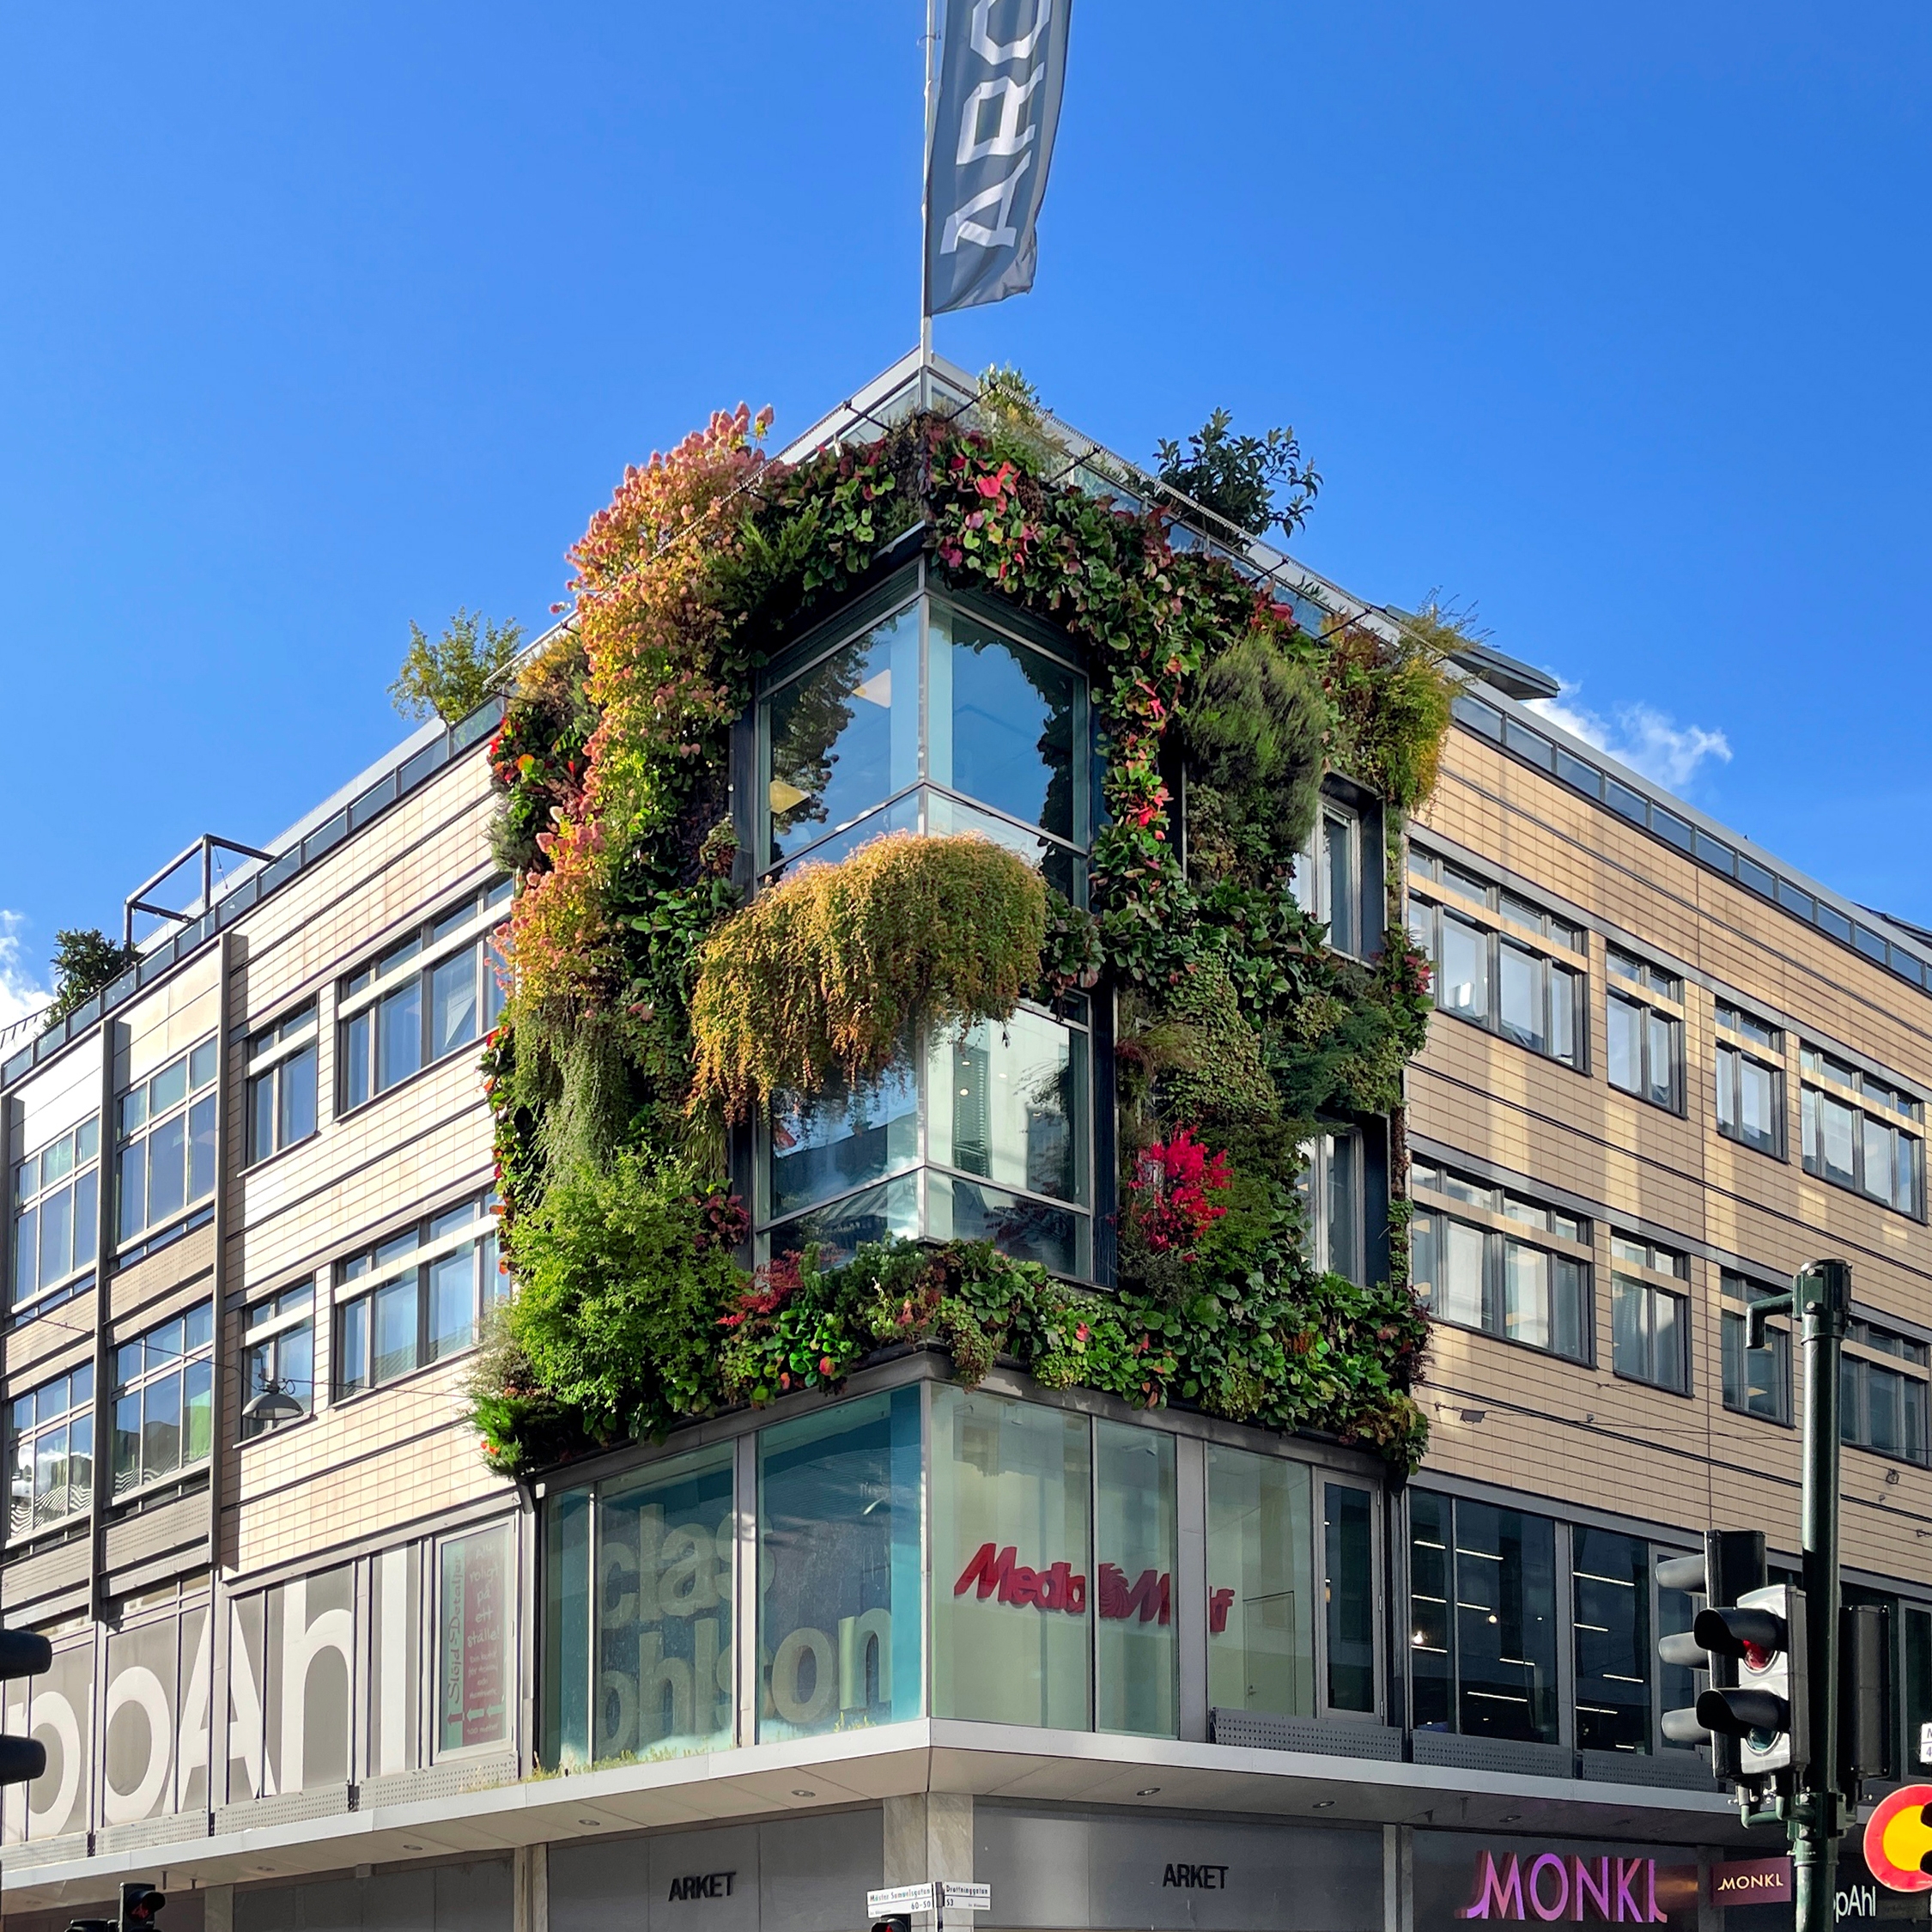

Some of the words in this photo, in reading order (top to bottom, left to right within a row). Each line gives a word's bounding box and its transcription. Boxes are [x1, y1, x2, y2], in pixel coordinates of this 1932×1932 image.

[470, 1560, 501, 1583] roligt
[477, 1583, 492, 1608] på
[475, 1605, 494, 1623] ett
[467, 1625, 501, 1648] ställe!
[668, 1871, 737, 1902] ARKET
[1163, 1863, 1229, 1889] ARKET
[1455, 1850, 1668, 1923] MONKI
[1717, 1873, 1784, 1891] MONKI
[870, 1893, 890, 1902] Mäster
[946, 1884, 988, 1895] Drottninggatan
[911, 1900, 931, 1910] 60-50
[946, 1898, 954, 1907] 53
[1833, 1885, 1876, 1923] pAhl
